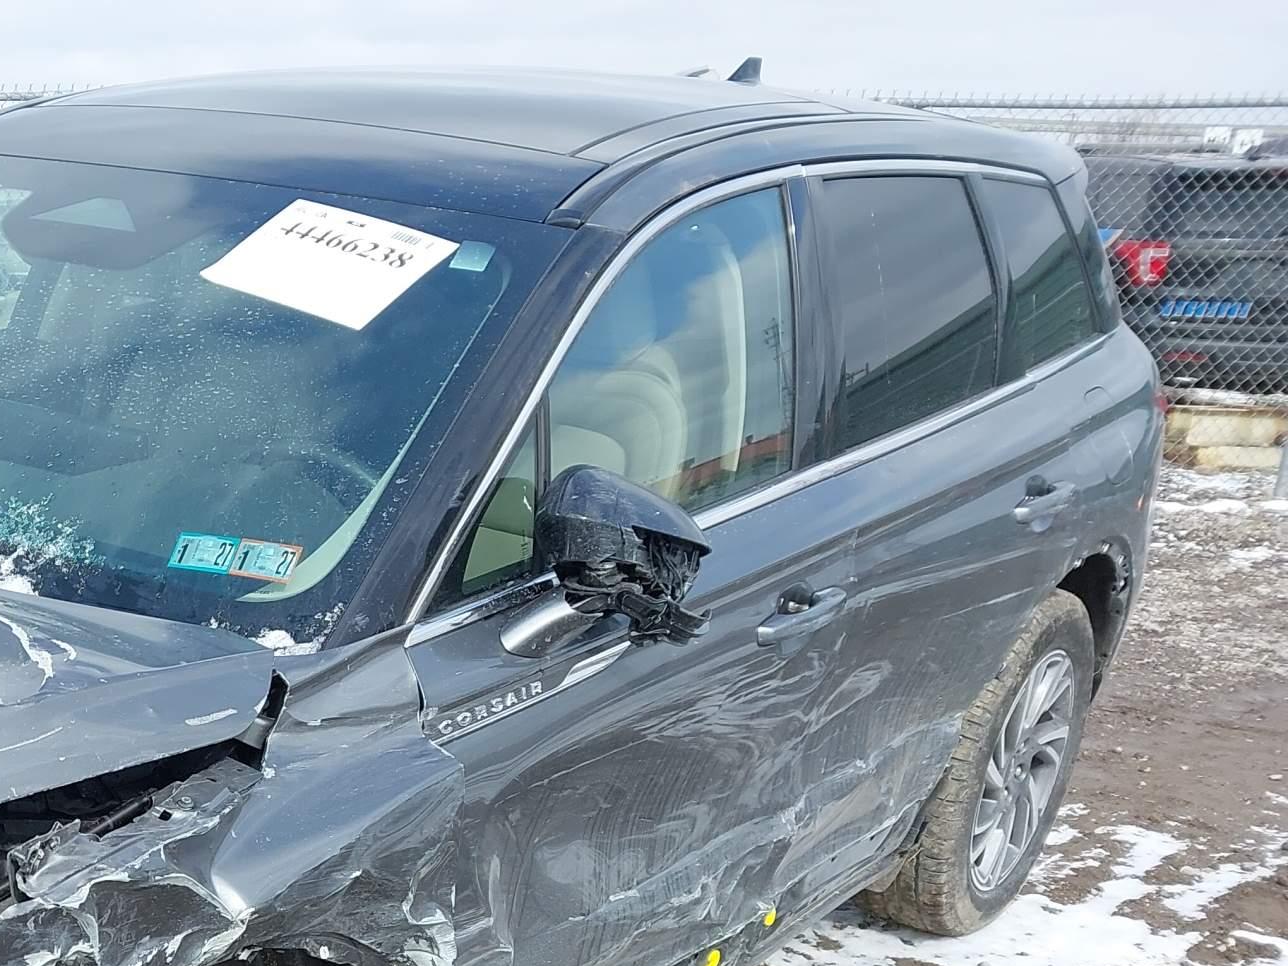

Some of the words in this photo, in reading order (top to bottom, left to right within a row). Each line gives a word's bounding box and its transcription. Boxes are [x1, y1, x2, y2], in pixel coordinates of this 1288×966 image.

[279, 222, 414, 268] 44466238
[213, 542, 235, 567] 27
[275, 550, 297, 577] 27
[437, 680, 543, 735] CORSAIR
